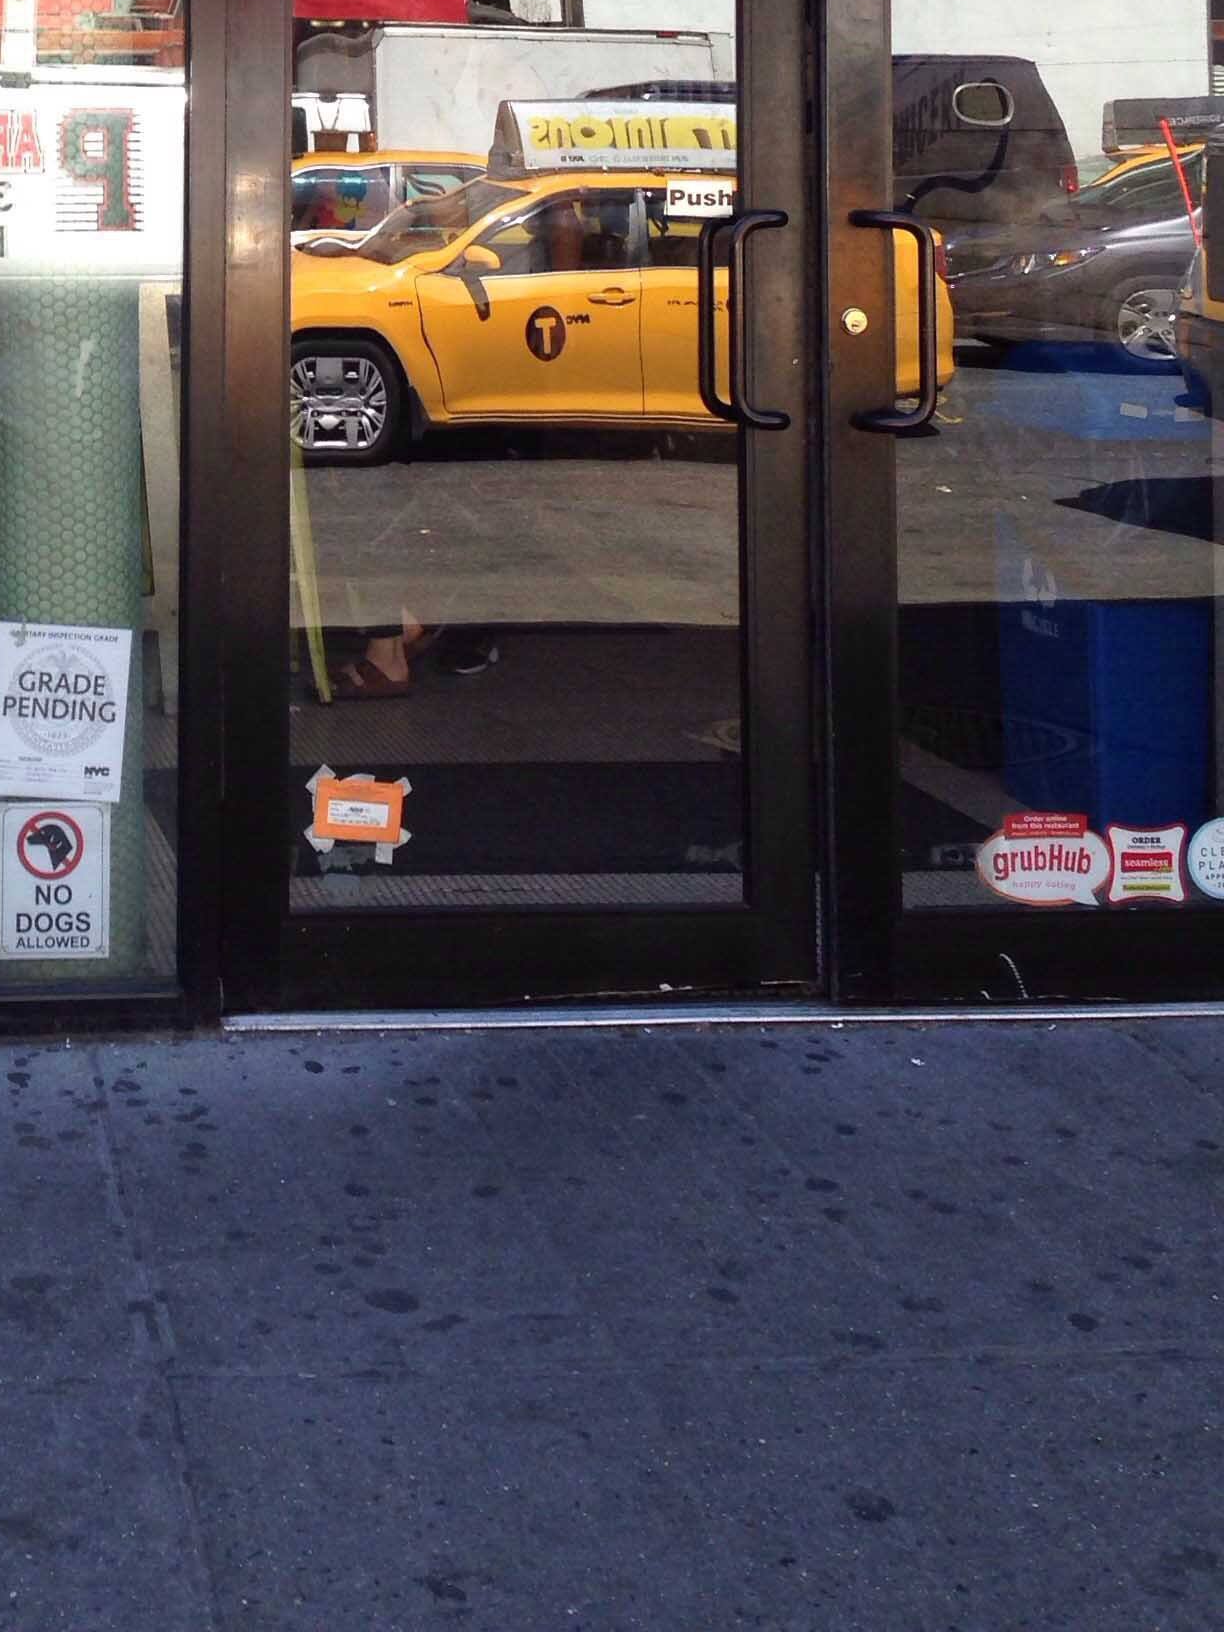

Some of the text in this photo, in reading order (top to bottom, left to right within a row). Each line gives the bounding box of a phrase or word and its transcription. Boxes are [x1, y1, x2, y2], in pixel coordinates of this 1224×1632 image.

[669, 189, 734, 207] Push
[18, 670, 106, 697] GRADE
[2, 695, 117, 724] PENDING
[84, 765, 110, 777] NYC
[1023, 815, 1044, 823] Order
[1131, 836, 1161, 844] ORDER
[992, 843, 1092, 880] grubHub
[1124, 857, 1169, 867] seamless
[34, 884, 73, 905] NO
[15, 912, 91, 933] DOGS
[15, 936, 91, 949] ALLOWED
